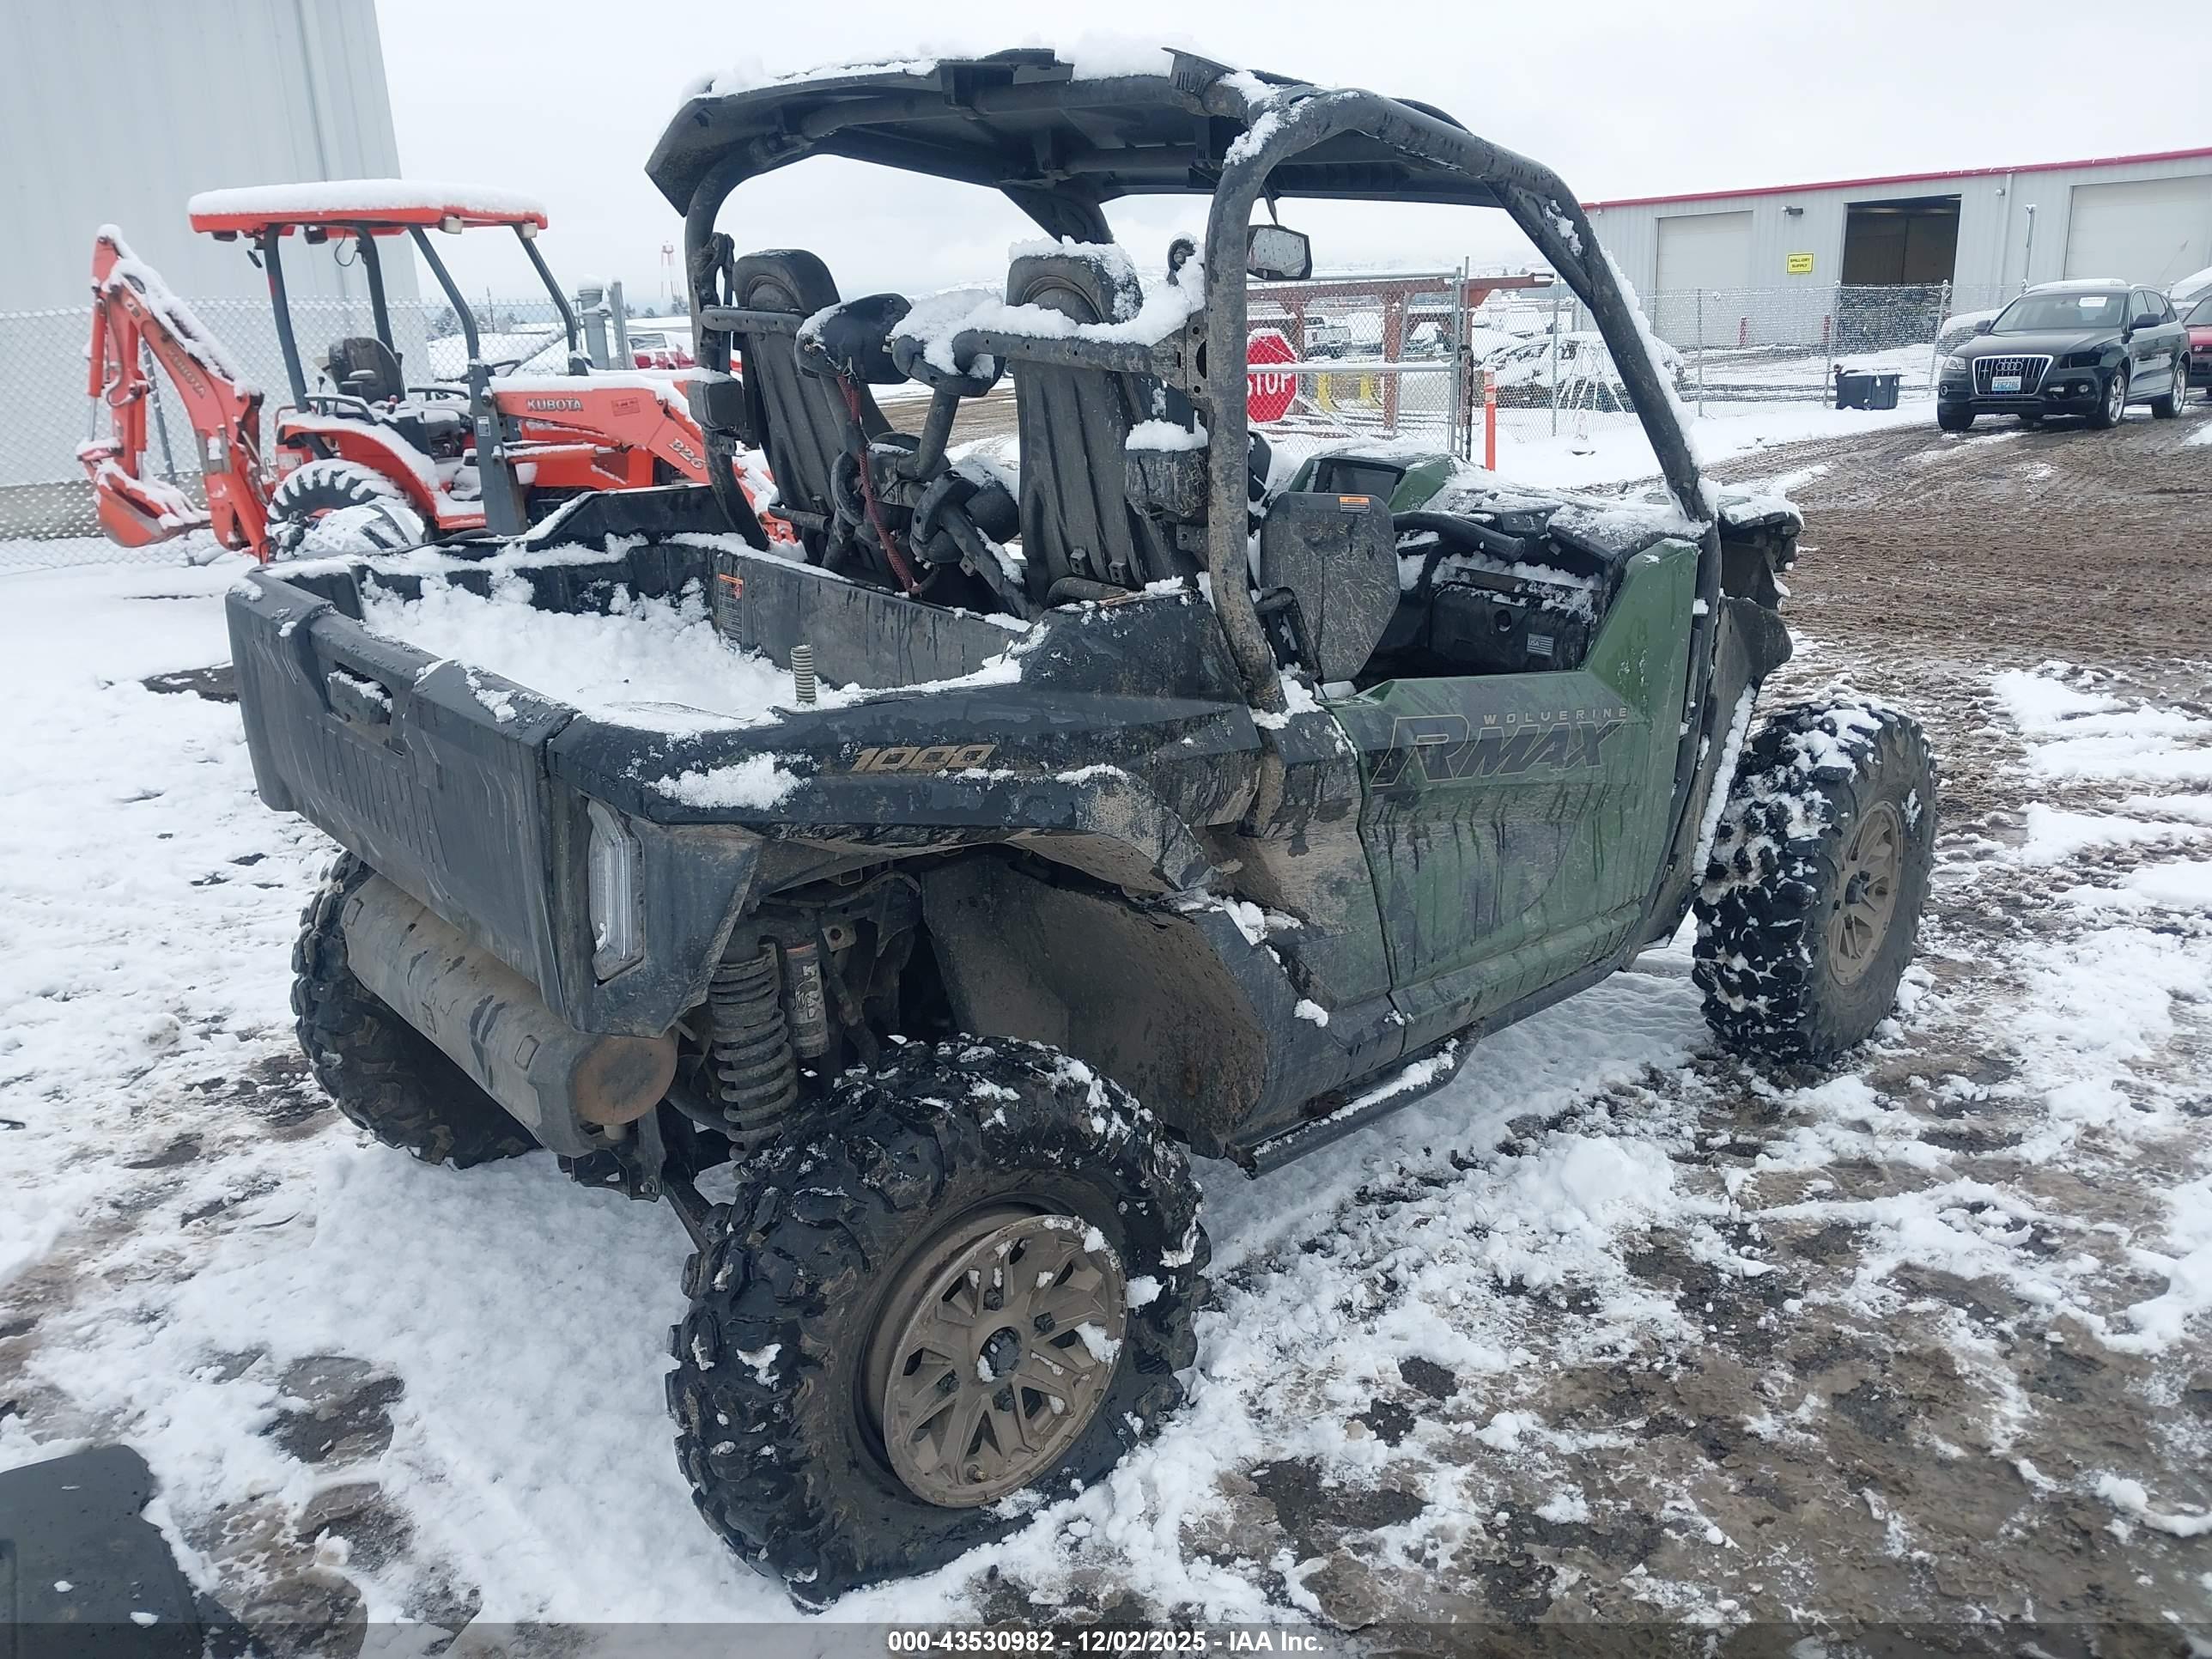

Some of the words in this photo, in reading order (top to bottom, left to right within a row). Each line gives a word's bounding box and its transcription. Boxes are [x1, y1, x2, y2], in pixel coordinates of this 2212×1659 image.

[527, 398, 584, 412] KUBOTA
[1483, 708, 1627, 726] WOLVERINE
[851, 744, 996, 772] 1000
[1370, 714, 1627, 787] RMAX
